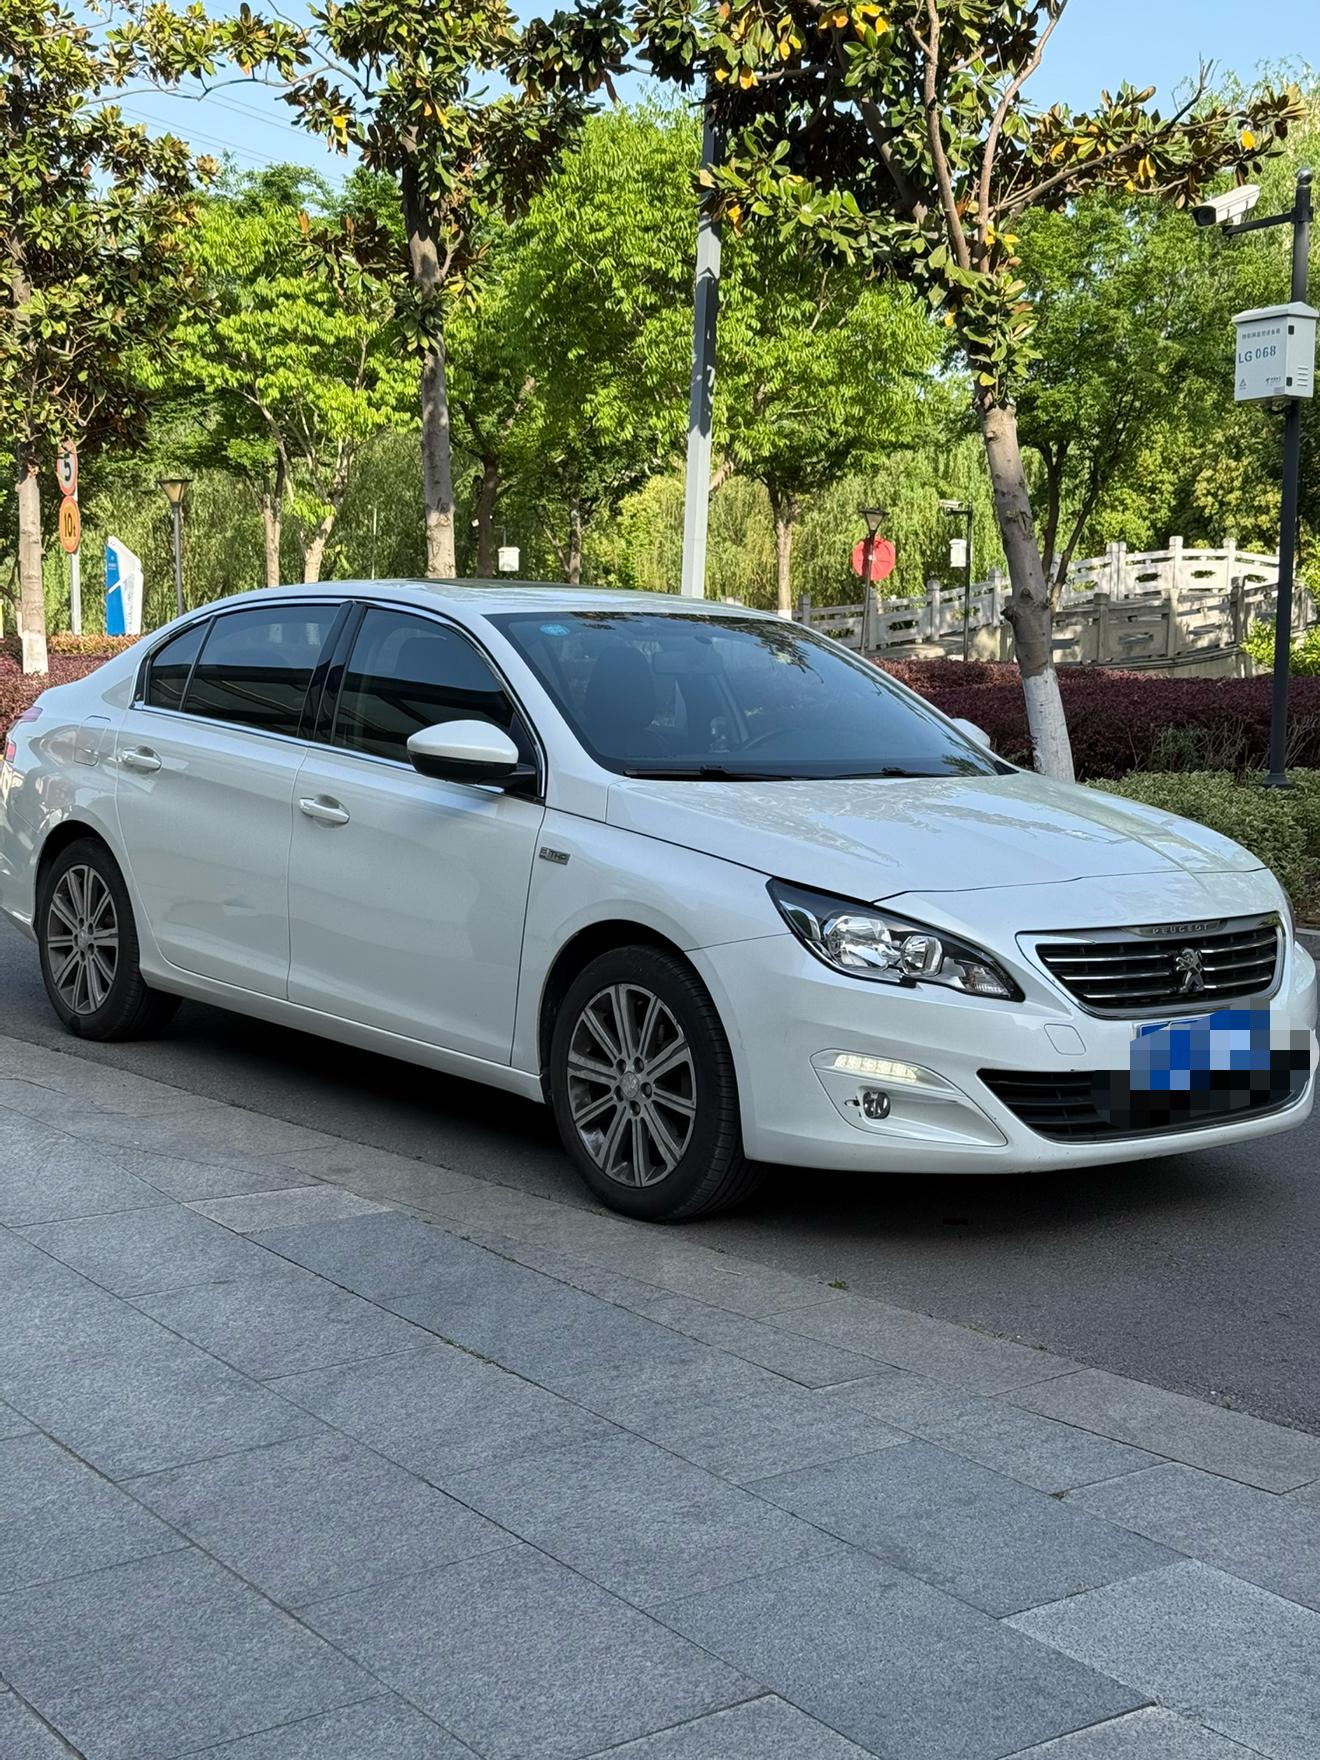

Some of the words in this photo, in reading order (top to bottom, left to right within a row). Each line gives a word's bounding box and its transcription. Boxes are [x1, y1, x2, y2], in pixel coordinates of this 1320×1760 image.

[1238, 350, 1253, 364] LG
[1255, 345, 1277, 359] 068
[63, 453, 72, 482] 5
[1152, 923, 1208, 934] PEUGEOT
